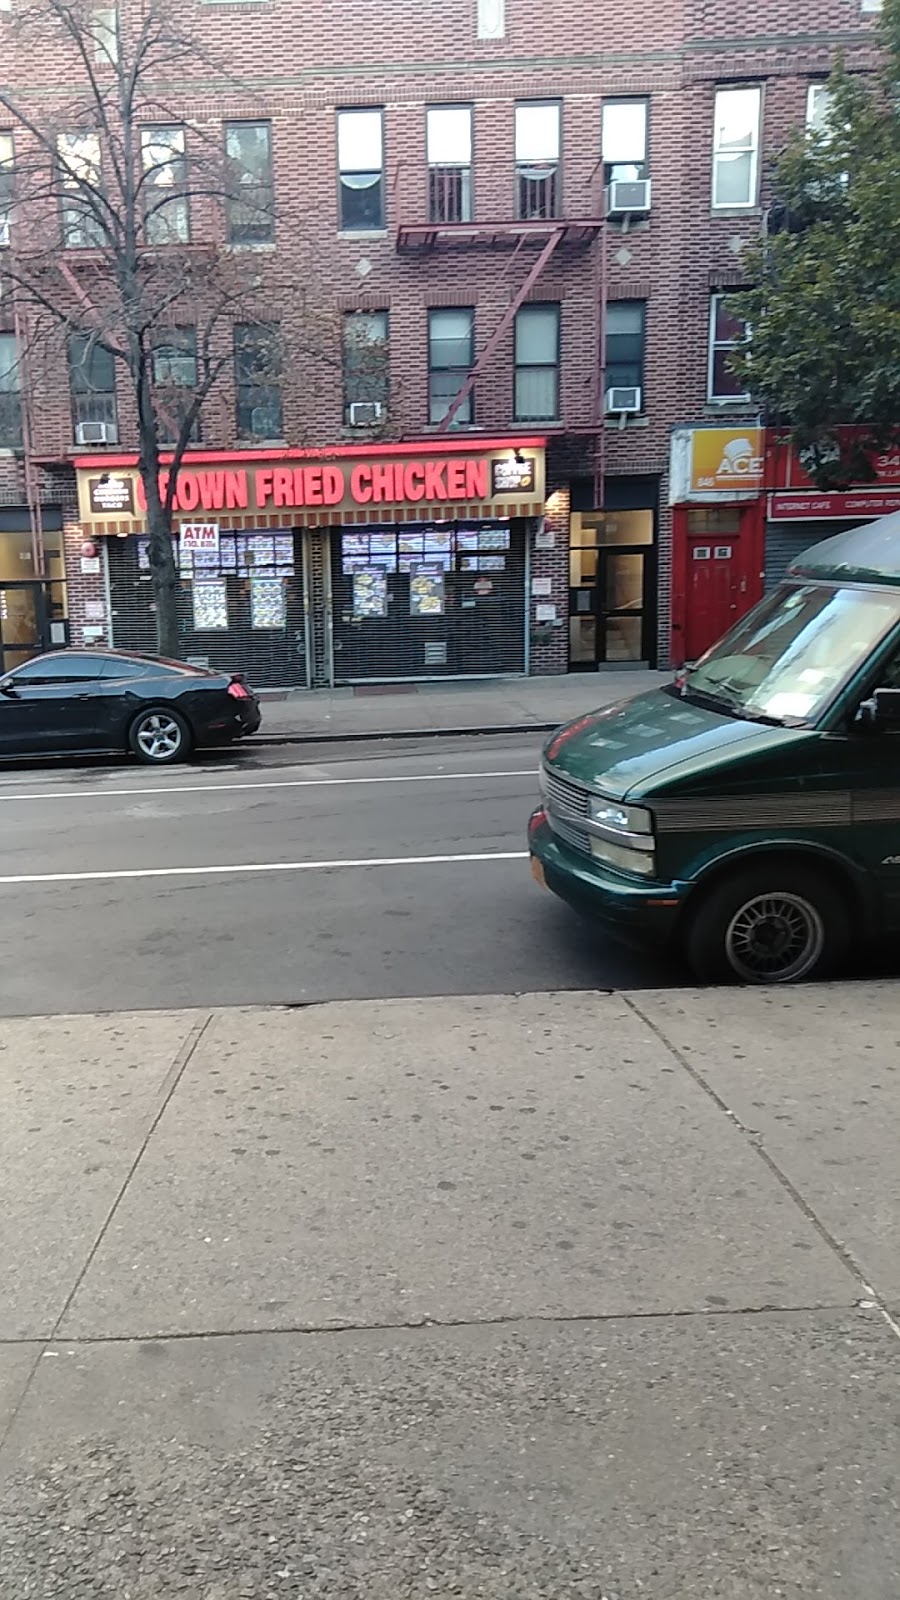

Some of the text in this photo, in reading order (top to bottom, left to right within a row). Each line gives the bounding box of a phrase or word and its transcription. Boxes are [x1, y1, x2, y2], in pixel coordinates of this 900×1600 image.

[716, 457, 764, 474] ACE
[255, 465, 344, 508] FRIED
[350, 460, 487, 504] CHICKEN
[811, 500, 832, 510] CAFE
[844, 499, 884, 509] COMPUTER
[184, 526, 216, 540] ATM
